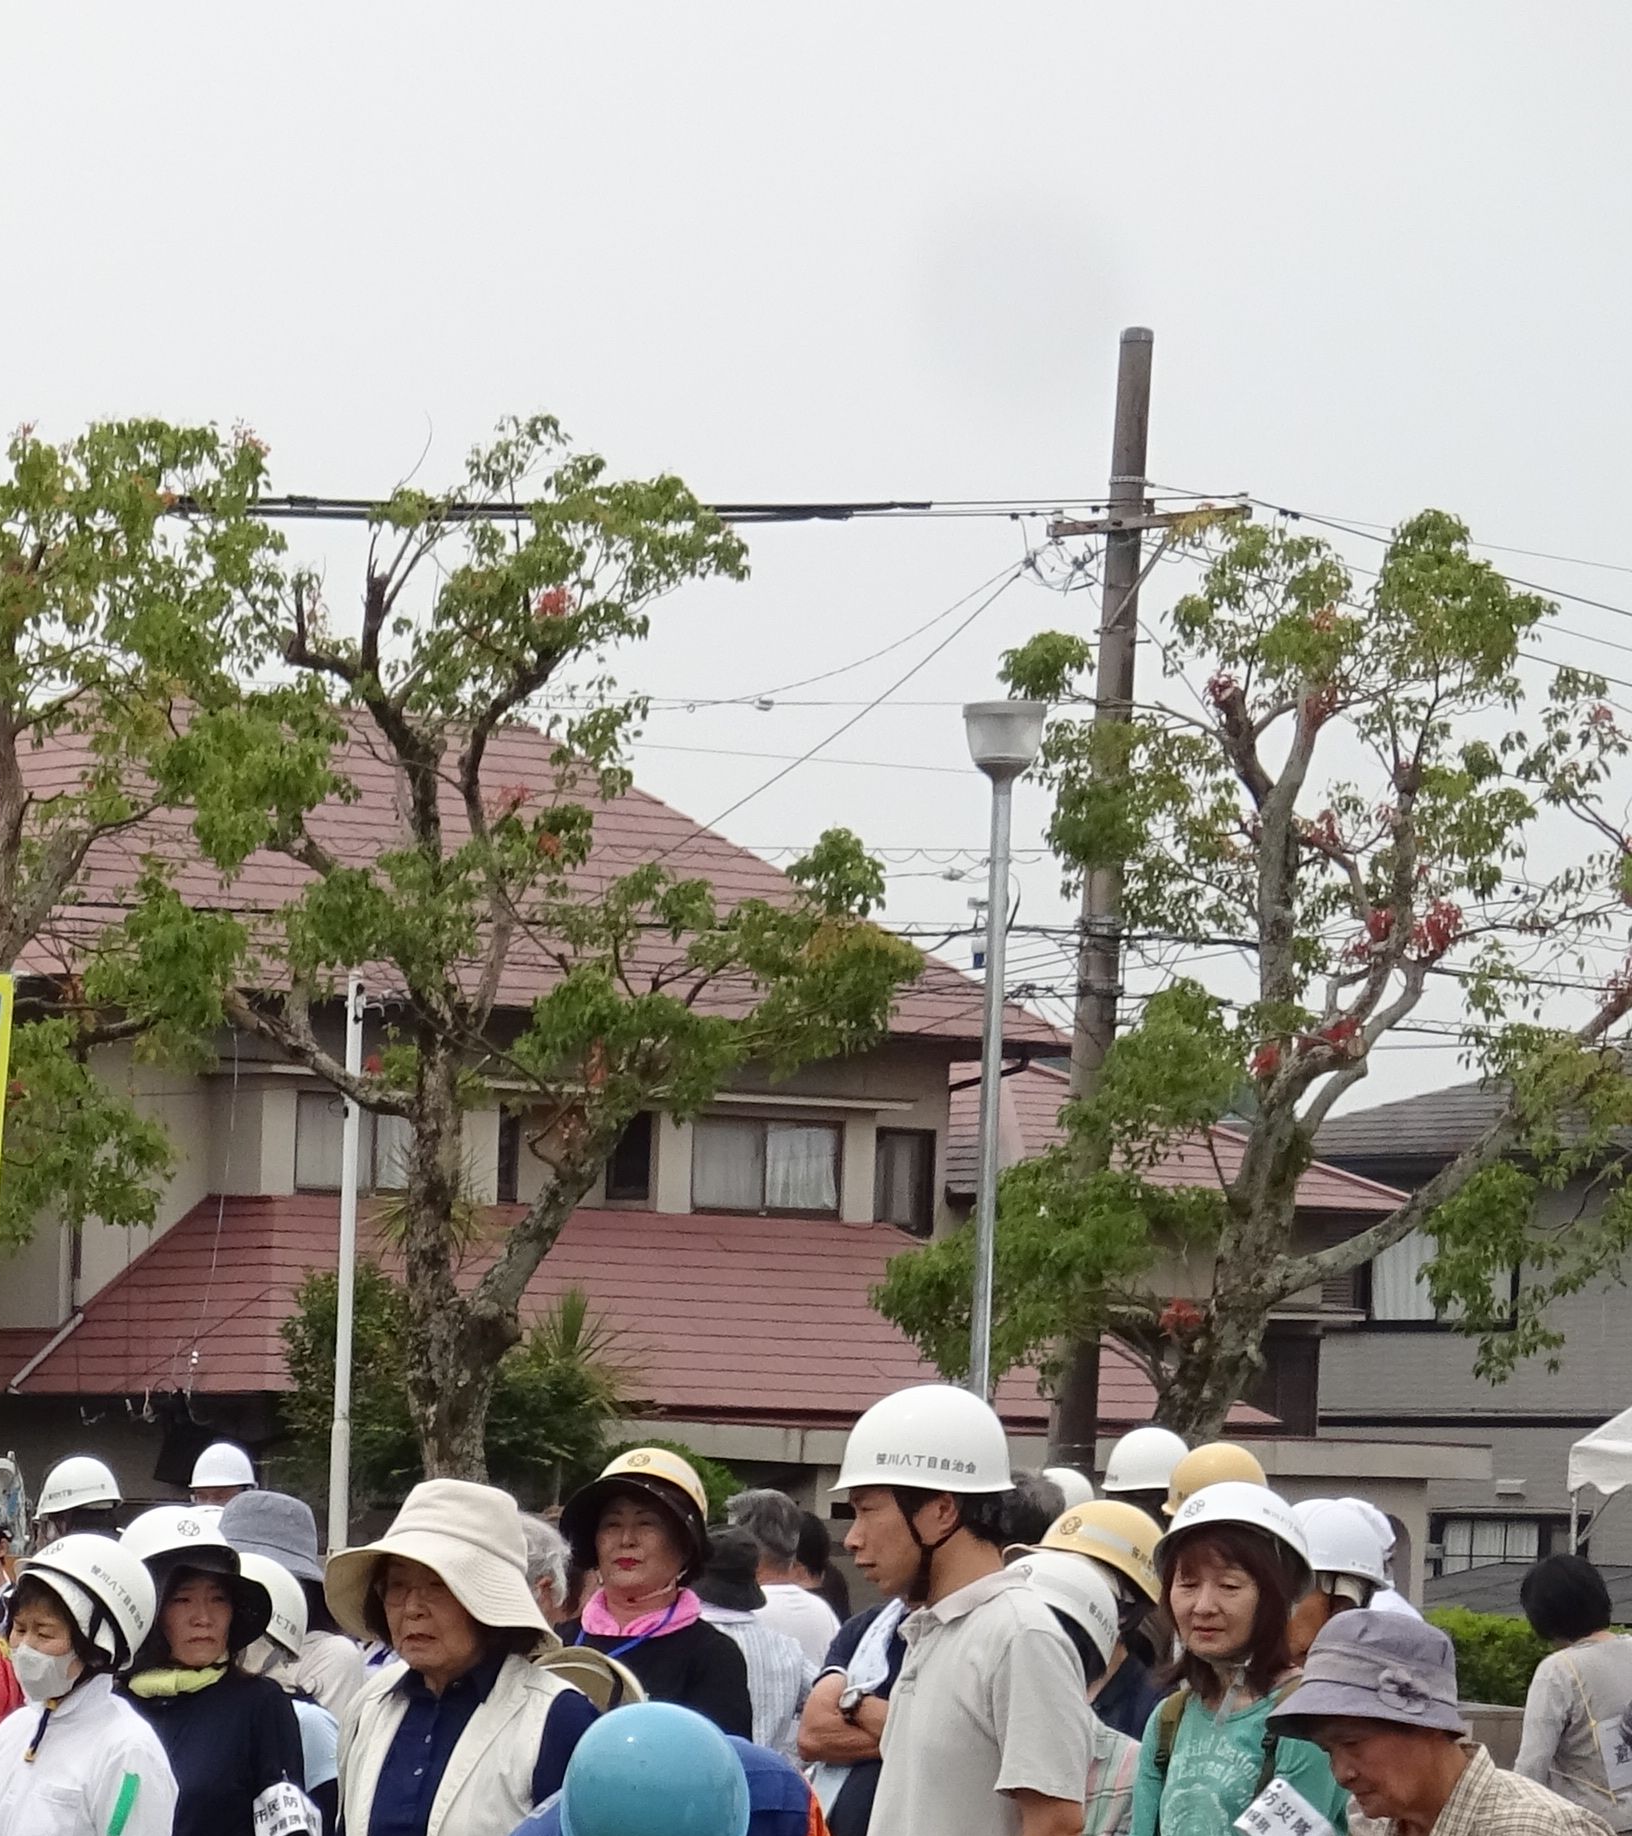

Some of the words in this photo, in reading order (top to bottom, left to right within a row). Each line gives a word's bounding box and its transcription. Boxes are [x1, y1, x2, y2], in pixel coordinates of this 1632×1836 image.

[876, 1452, 976, 1474] 笹川八丁目自治会
